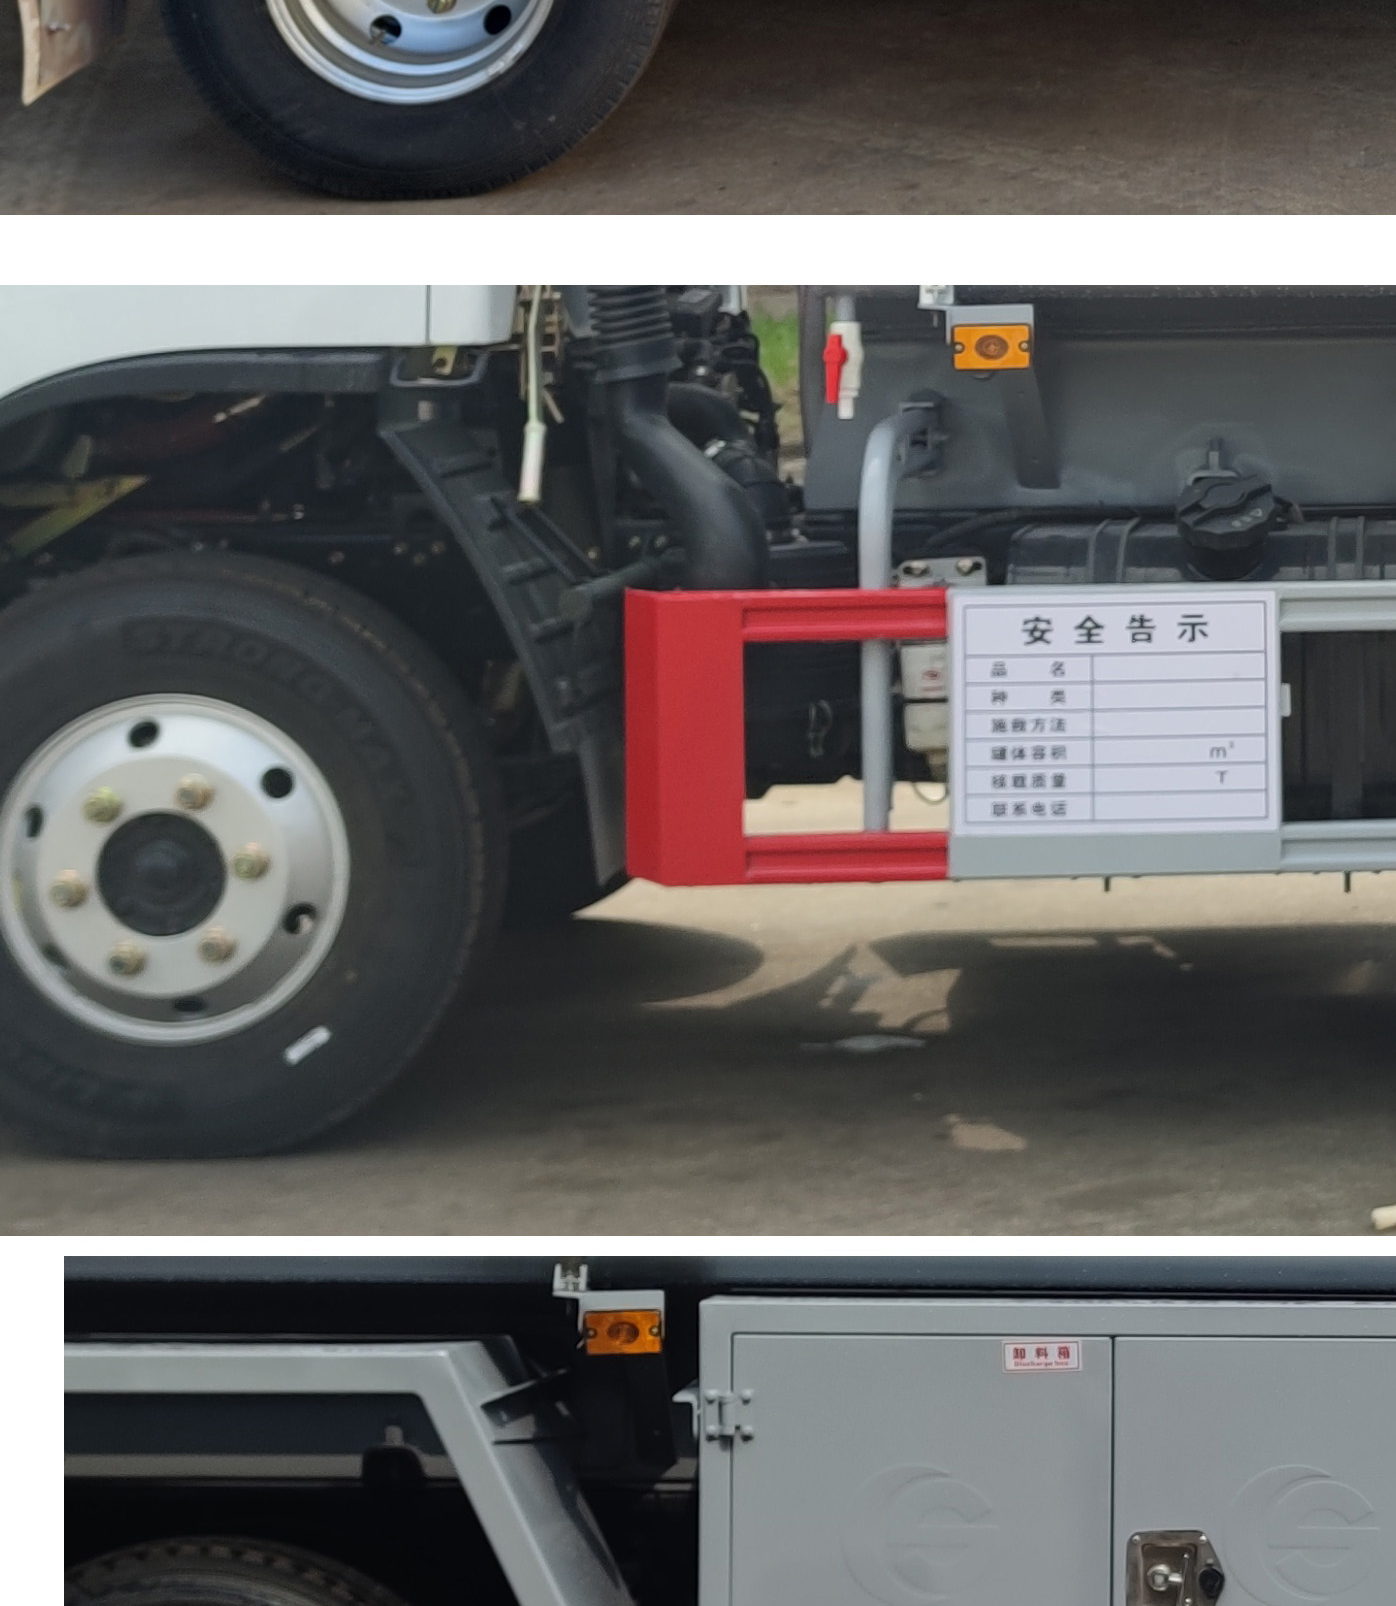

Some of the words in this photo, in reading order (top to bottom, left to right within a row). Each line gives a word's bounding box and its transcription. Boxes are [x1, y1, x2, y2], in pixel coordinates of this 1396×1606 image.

[1023, 614, 1209, 646] 安全告示
[1215, 771, 1228, 783] T
